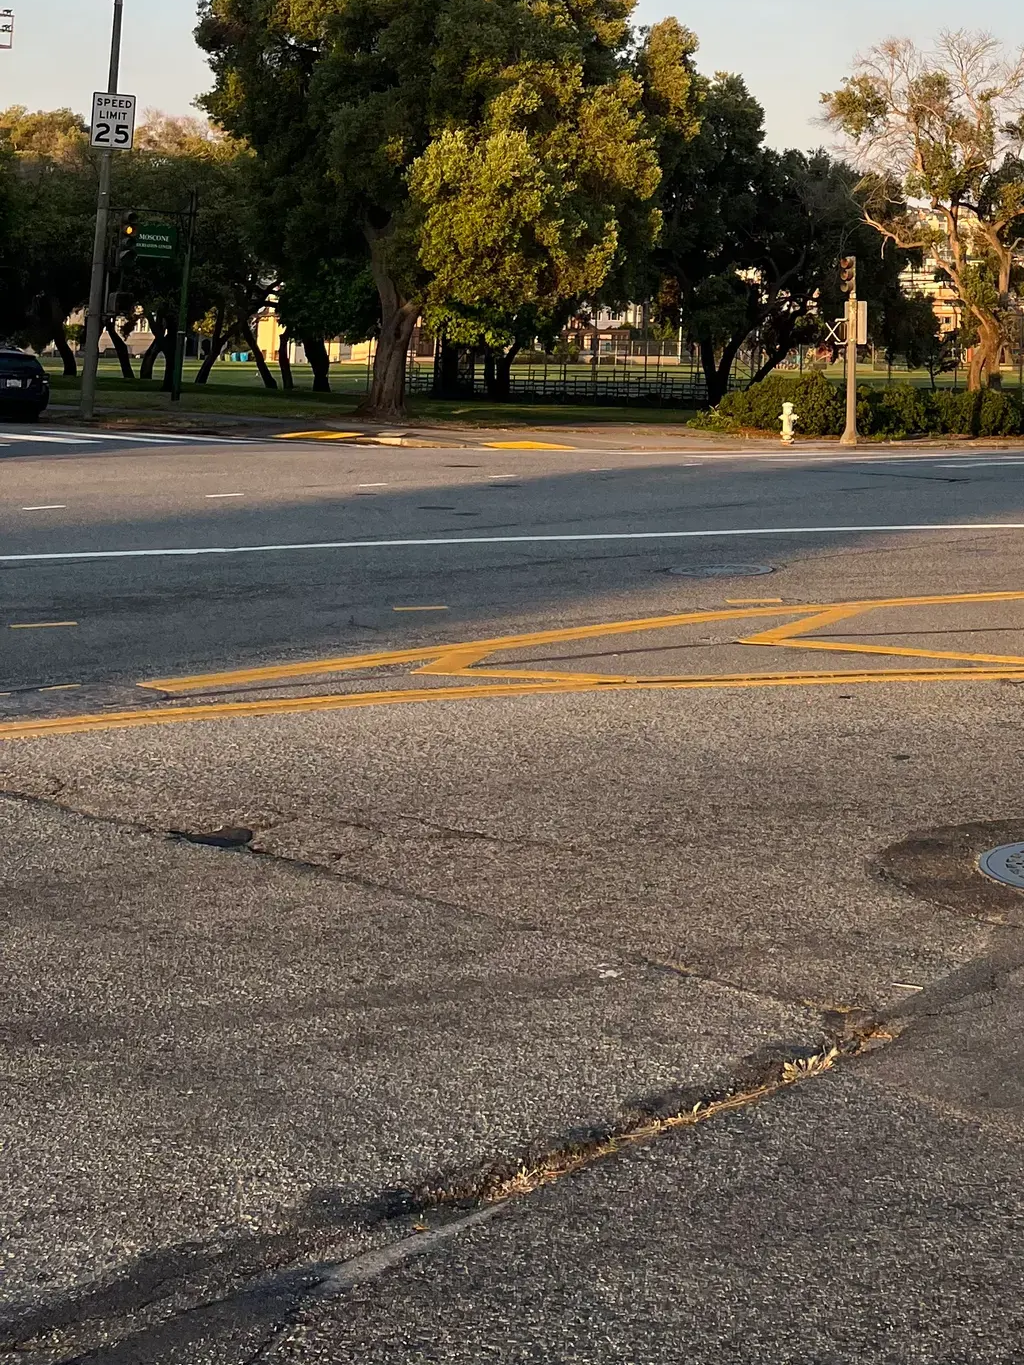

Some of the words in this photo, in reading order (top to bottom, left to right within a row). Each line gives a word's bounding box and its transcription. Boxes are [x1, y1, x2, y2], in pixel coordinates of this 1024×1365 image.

[96, 97, 132, 109] SPEED
[99, 110, 128, 121] LIMIT
[95, 122, 129, 144] 25
